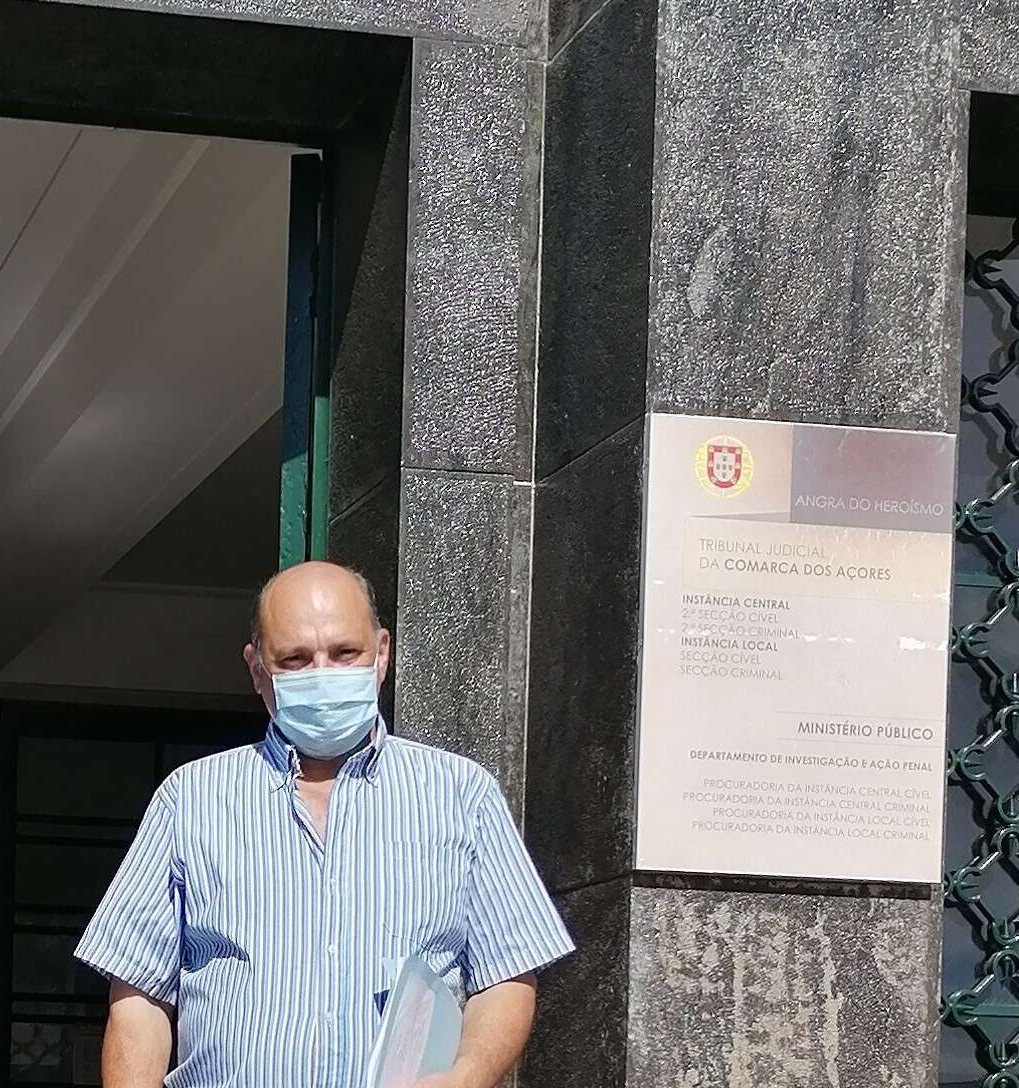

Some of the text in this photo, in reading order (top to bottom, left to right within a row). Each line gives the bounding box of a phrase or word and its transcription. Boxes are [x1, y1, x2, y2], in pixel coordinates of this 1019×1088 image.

[796, 496, 943, 516] ANGRA DO HEROÍSMO
[700, 538, 827, 559] TRIBUNAL JUDICIAL
[699, 557, 891, 581] DA COMARCA DOS AÇORES
[682, 594, 790, 610] INSTÂNCIA CENTRAL
[698, 608, 746, 622] SECÇÃO
[698, 623, 746, 636] SECÇÃO
[748, 626, 800, 639] CRIMINAL
[681, 636, 778, 652] INSTÂNCIA LOCAL
[680, 650, 728, 664] SECÇÃO
[680, 664, 783, 680] SECÇÃO CRIMINAL
[798, 720, 933, 740] MINISTÉRIO PÚBLICO
[690, 750, 932, 772] DEPARTAMENTO DE INVESTIGAÇÃO E AÇÃO PENAL
[703, 779, 785, 792] PROCURADORIA
[787, 783, 803, 793] DA
[805, 783, 856, 796] INSTÂNCIA
[859, 786, 902, 798] CENTRAL
[683, 792, 931, 813] PROCURADORIA DA INSTÂNCIA CENTRAL CRIMINAL
[712, 808, 793, 820] PROCURADORIA
[796, 811, 810, 821] DA
[814, 812, 865, 825] INSTÂNCIA
[868, 815, 902, 826] LOCAL
[692, 821, 930, 841] PROCURADORIA DA INSTÂNCIA LOCAL CRIMINAL
